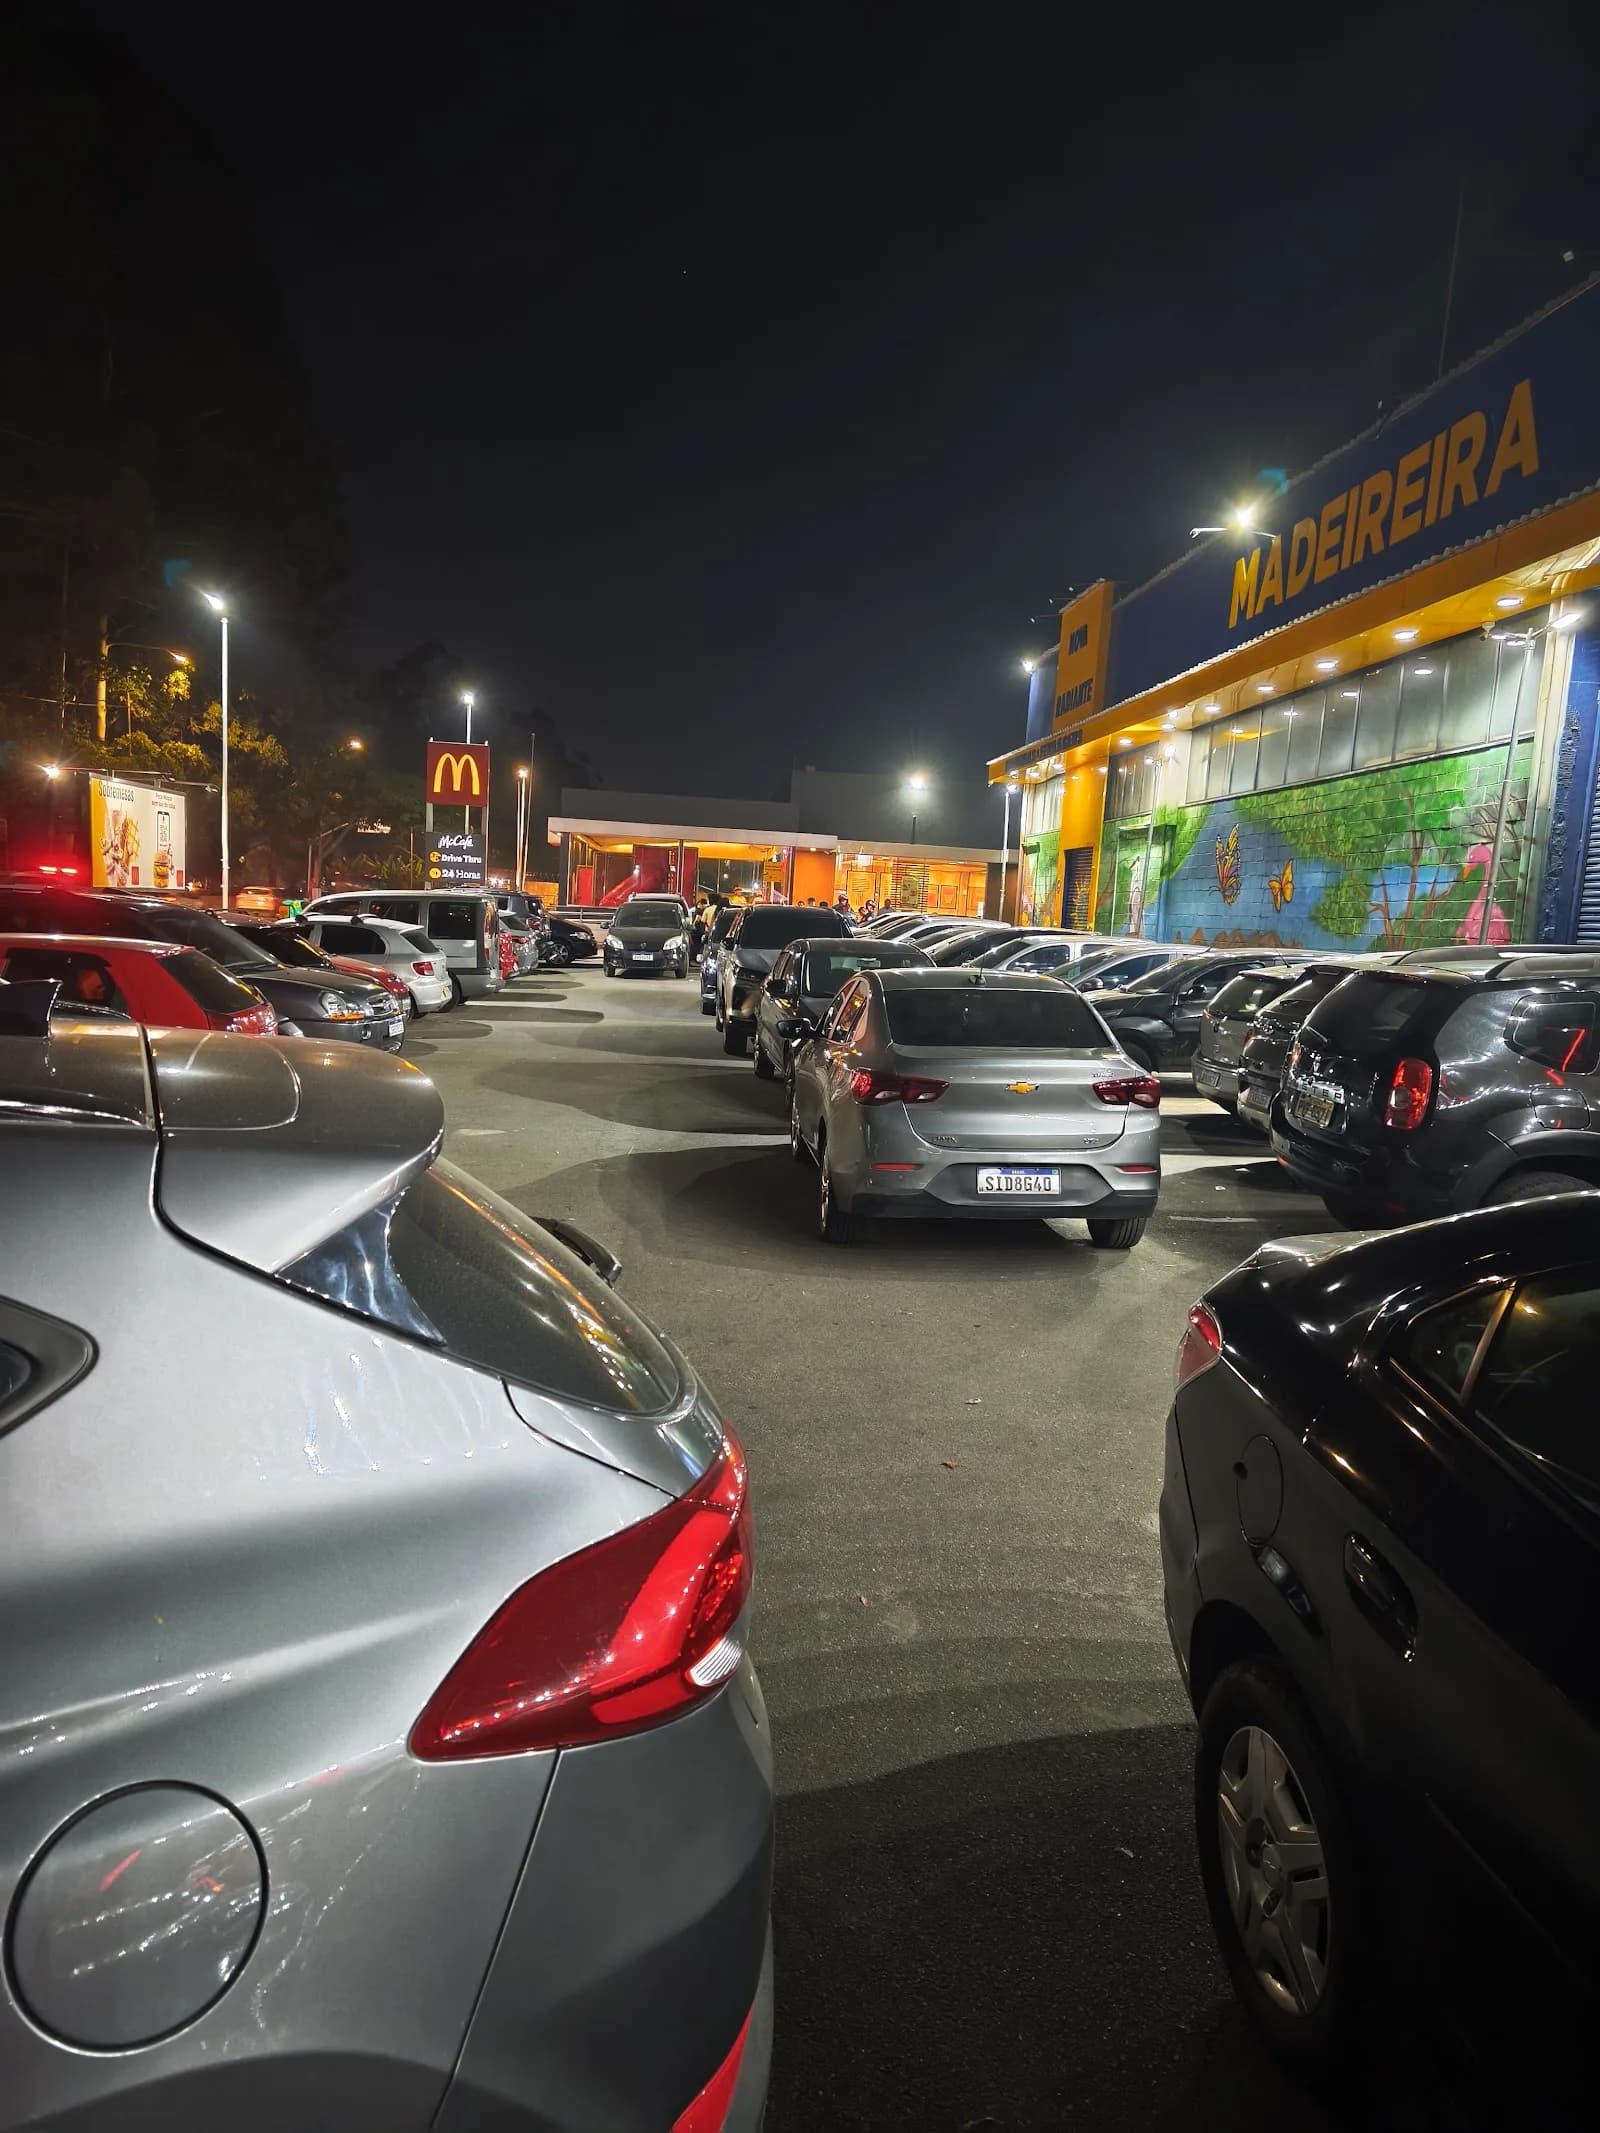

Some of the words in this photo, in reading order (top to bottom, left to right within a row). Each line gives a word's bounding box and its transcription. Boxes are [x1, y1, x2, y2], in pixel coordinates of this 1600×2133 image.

[1228, 378, 1539, 629] MADEIREIRA
[98, 781, 135, 803] Sobremesas
[441, 853, 462, 863] Drive
[463, 854, 482, 864] Thru
[441, 869, 455, 879] 24
[456, 869, 481, 880] Horas
